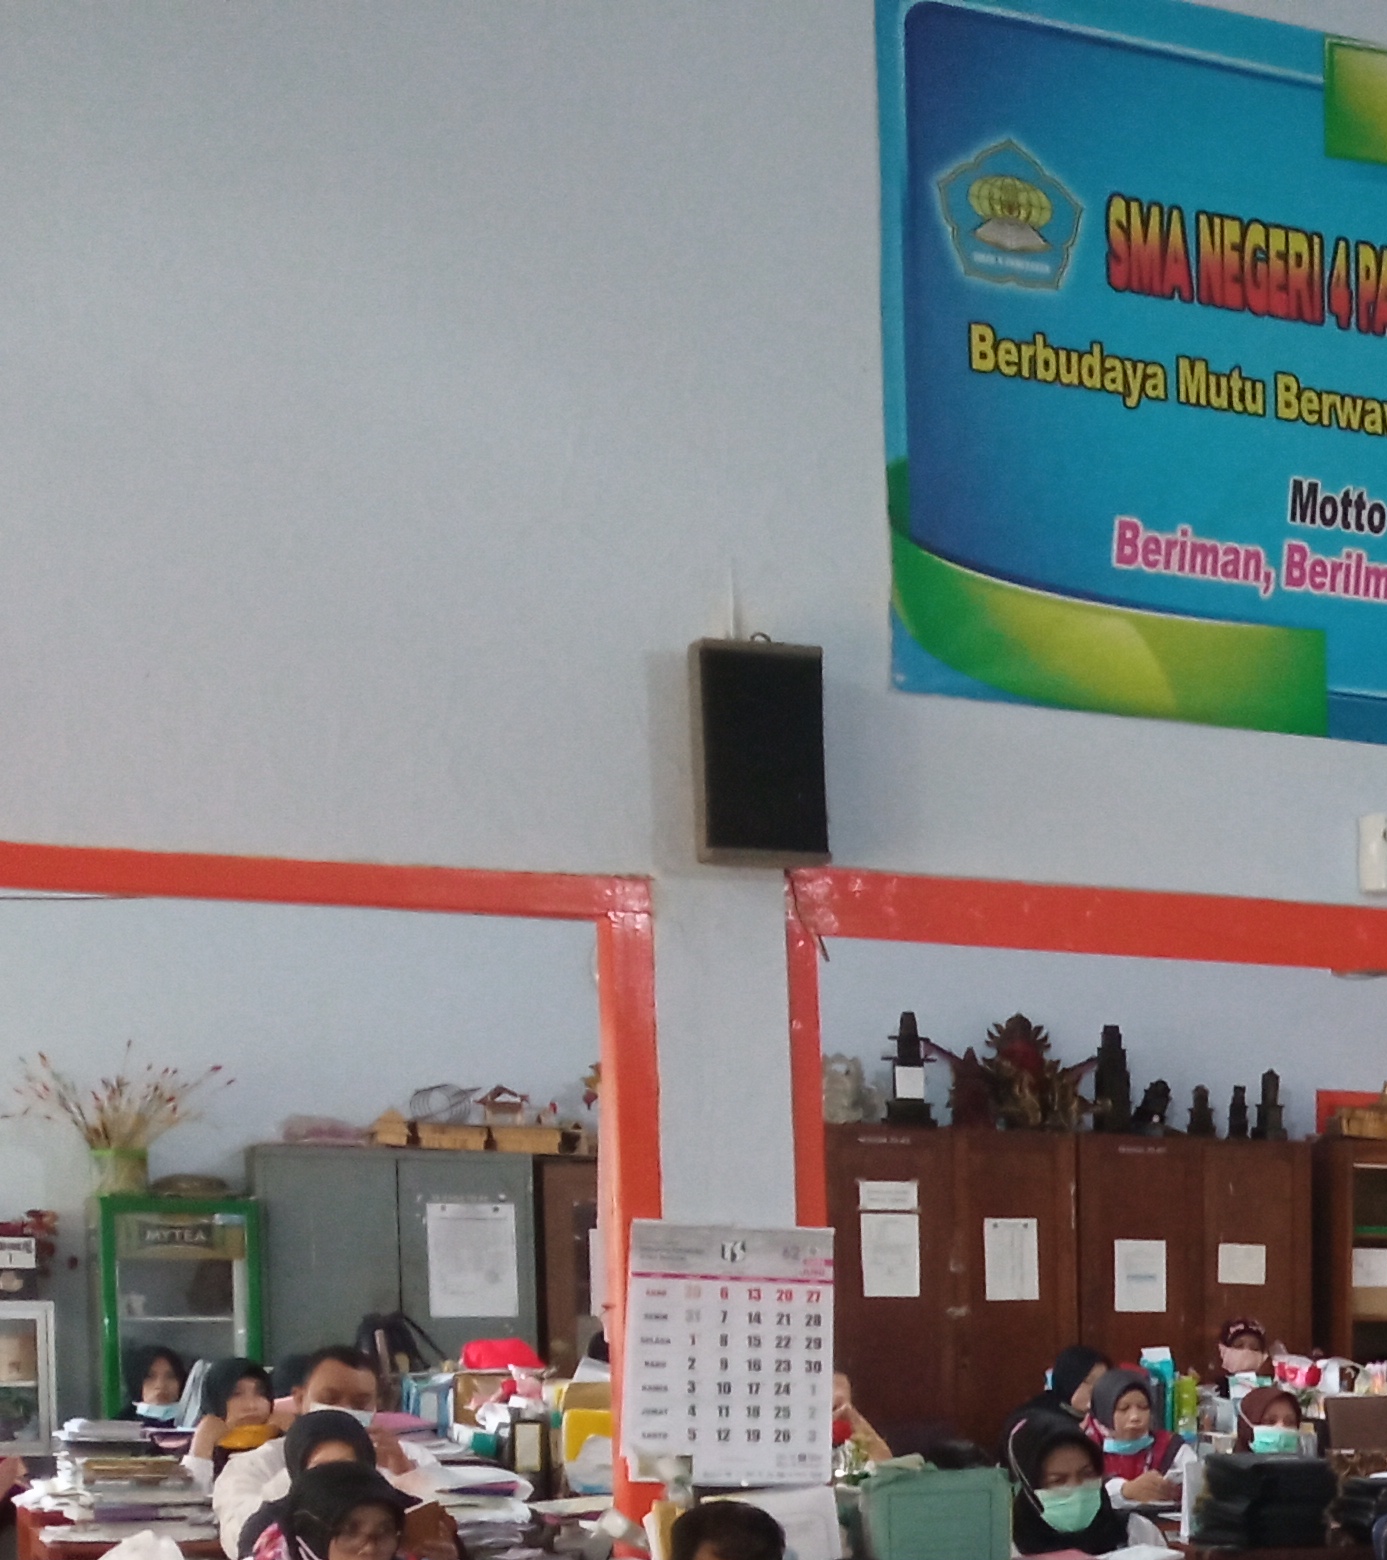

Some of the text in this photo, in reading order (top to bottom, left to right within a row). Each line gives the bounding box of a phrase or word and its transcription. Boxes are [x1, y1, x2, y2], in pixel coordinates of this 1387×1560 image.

[1106, 193, 1193, 304] SMA
[1198, 211, 1325, 326] NEGERI
[1328, 239, 1353, 331] 4
[969, 322, 1167, 408] Berbudaya
[1177, 358, 1266, 416] Mutu
[1289, 480, 1387, 536] Motto
[1113, 517, 1272, 597] Beriman,
[748, 1288, 761, 1301] 13
[776, 1289, 792, 1301] 20
[806, 1291, 821, 1303] 27
[721, 1311, 727, 1323] 7
[748, 1312, 761, 1325] 14
[776, 1313, 791, 1326] 21
[805, 1314, 822, 1327] 28
[747, 1335, 761, 1349] 15
[775, 1336, 791, 1349] 22
[805, 1337, 822, 1350] 29
[688, 1358, 696, 1370] 2
[720, 1358, 728, 1371] 9
[747, 1359, 761, 1372] 16
[775, 1360, 791, 1373] 23
[805, 1361, 822, 1373] 30
[688, 1382, 695, 1394] 3
[717, 1382, 731, 1395] 10
[747, 1383, 760, 1395] 17
[775, 1384, 791, 1396] 24
[688, 1405, 696, 1417] 4
[717, 1406, 730, 1418] 11
[746, 1406, 760, 1419] 18
[775, 1407, 791, 1420] 25
[687, 1429, 696, 1441] 5
[716, 1430, 730, 1442] 12
[746, 1430, 760, 1442] 19
[774, 1430, 791, 1443] 26
